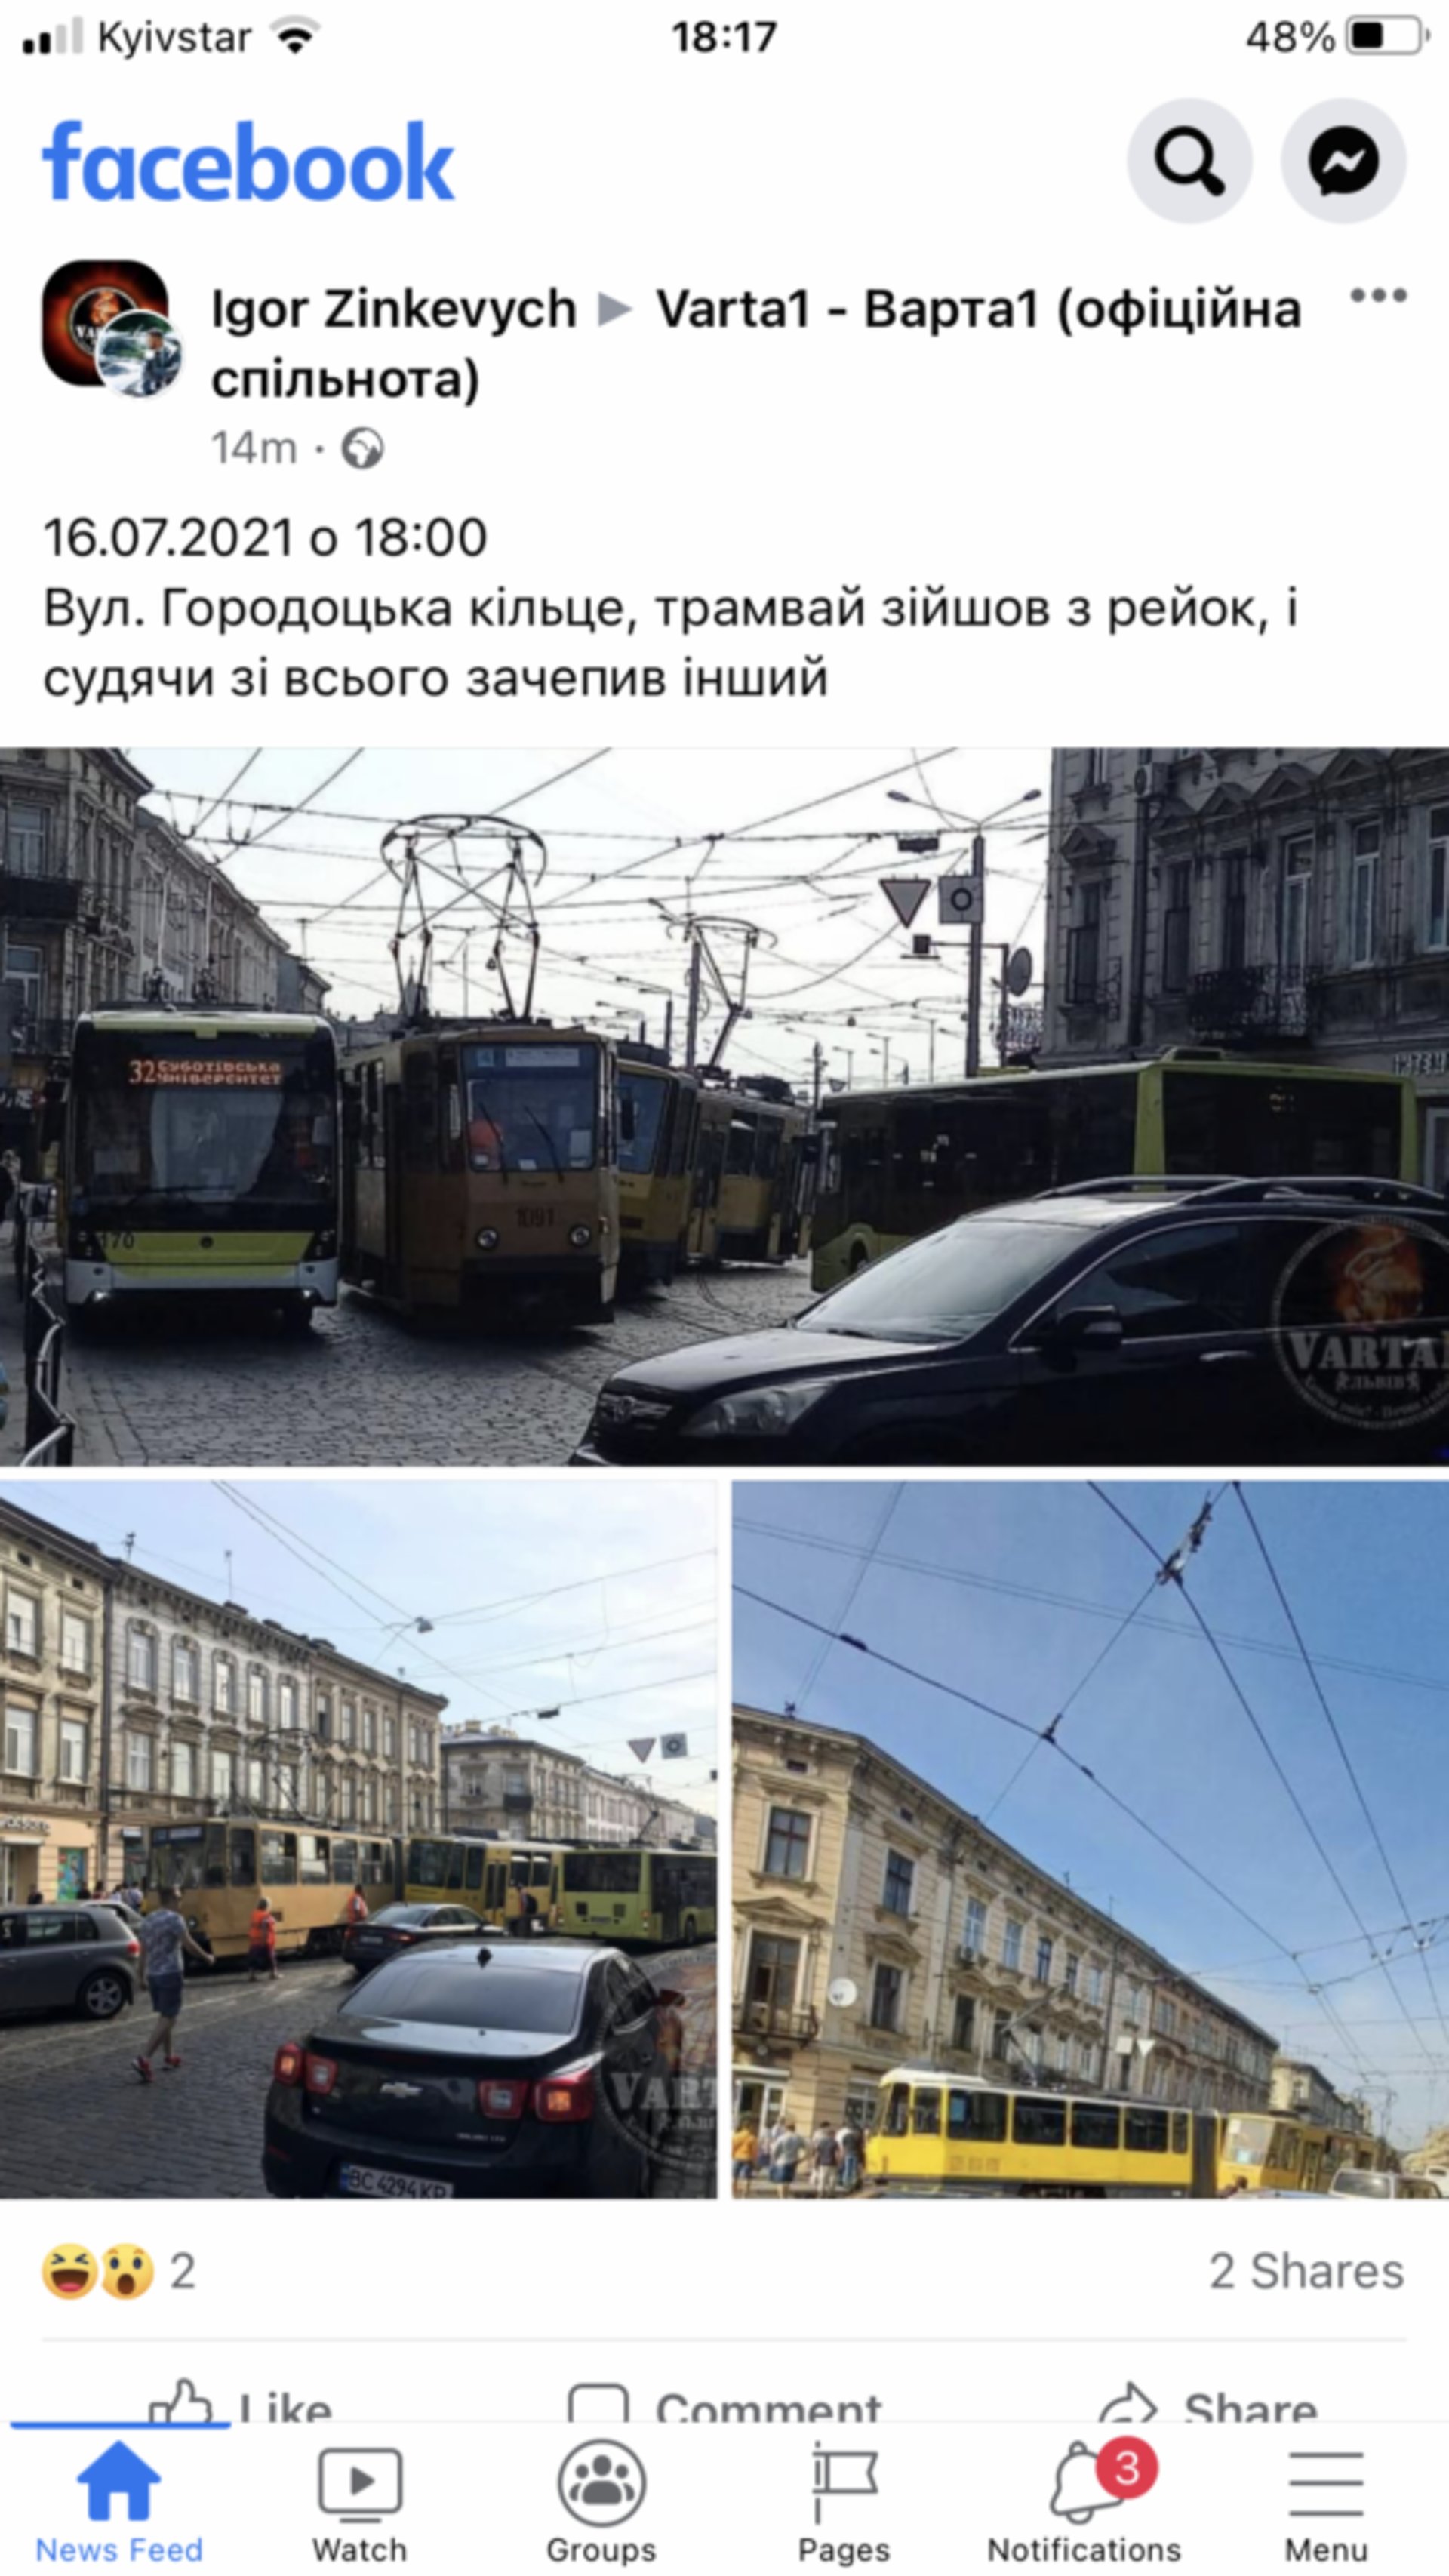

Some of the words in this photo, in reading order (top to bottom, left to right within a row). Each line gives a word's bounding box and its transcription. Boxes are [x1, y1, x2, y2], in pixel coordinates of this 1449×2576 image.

[99, 19, 253, 61] Kyivstar
[672, 20, 778, 54] 18:17
[1246, 20, 1337, 54] 48%
[41, 119, 456, 202] facebook
[213, 288, 310, 338] Igor
[324, 285, 577, 338] Zinkevych
[655, 288, 808, 328] Varta1
[827, 307, 848, 316] -
[865, 288, 1036, 338] Варта1
[1058, 285, 1302, 338] (офіційна
[211, 355, 479, 408] спільнота)
[212, 430, 296, 464] 14m
[44, 516, 291, 558] 16.07.2021
[309, 525, 338, 557] о
[355, 516, 488, 558] 18:00
[45, 586, 144, 636] Вул.
[163, 586, 451, 636] Городоцька
[470, 585, 637, 636] кільце,
[654, 584, 864, 636] трамвай
[881, 584, 1051, 627] зійшов
[1067, 596, 1091, 627] з
[1109, 584, 1268, 636] рейок,
[1288, 585, 1297, 627] і
[44, 666, 214, 706] судячи
[230, 655, 268, 697] зі
[285, 666, 449, 697] всього
[466, 666, 666, 697] зачепив
[684, 654, 827, 697] інший
[129, 1060, 155, 1084] 32
[377, 2174, 416, 2199] 4294
[171, 2251, 195, 2289] 2
[1211, 2251, 1235, 2289] 2
[1252, 2251, 1404, 2290] Shares
[656, 2393, 882, 2422] Comment
[1186, 2392, 1318, 2422] Share
[1115, 2450, 1140, 2485] 3
[36, 2538, 118, 2562] News
[130, 2537, 202, 2562] Feed
[312, 2537, 407, 2562] Watch
[546, 2537, 657, 2567] Groups
[799, 2537, 891, 2568] Pages
[988, 2536, 1182, 2562] Notifications
[1285, 2538, 1368, 2562] Menu
